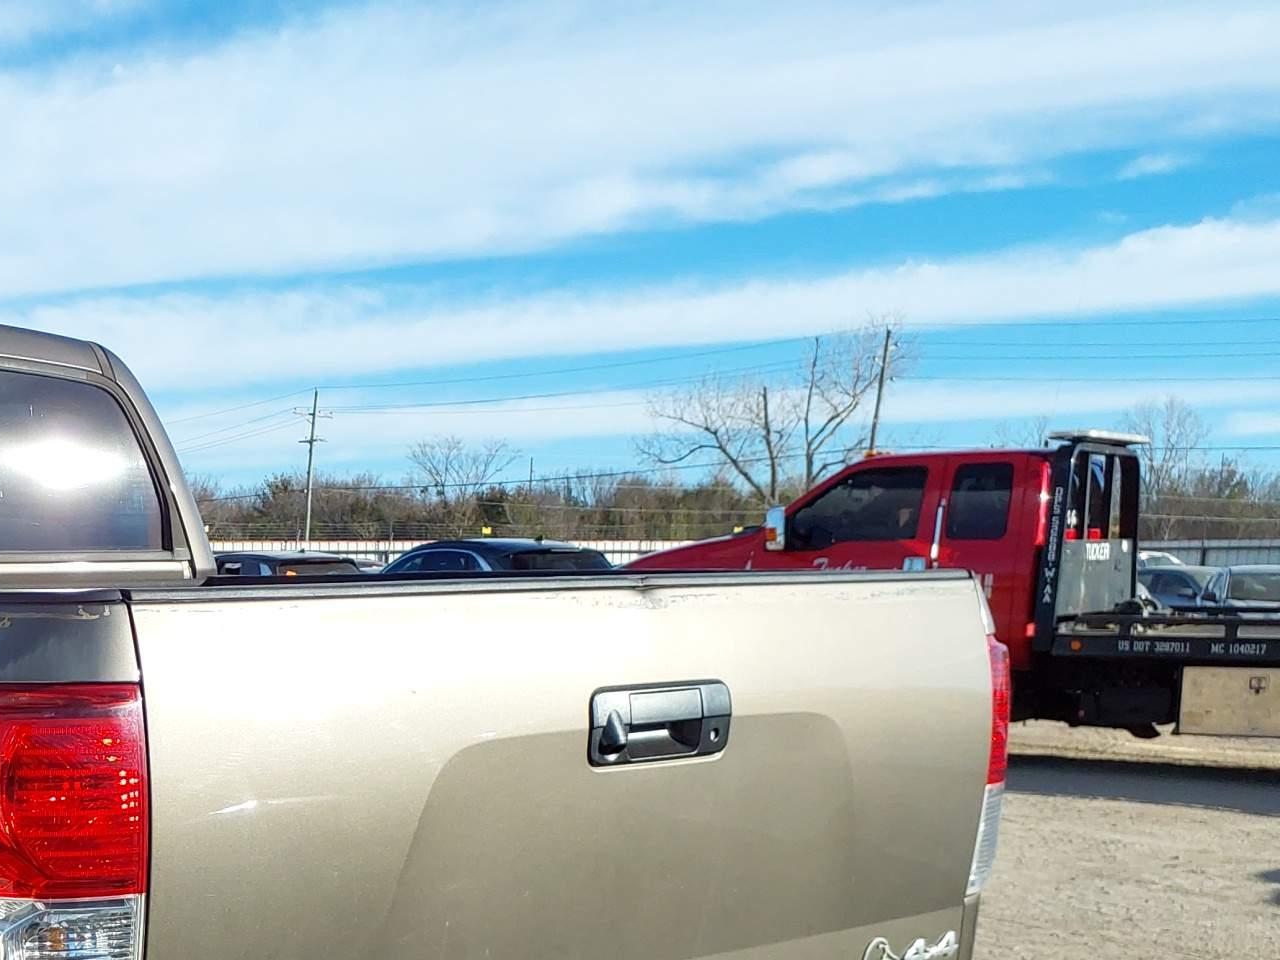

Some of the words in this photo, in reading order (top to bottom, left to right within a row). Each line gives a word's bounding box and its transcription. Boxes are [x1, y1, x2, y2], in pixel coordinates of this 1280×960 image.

[1085, 542, 1110, 561] TUCKER
[1118, 640, 1130, 651] US
[1133, 640, 1151, 652] DOT
[1211, 643, 1225, 655] MC
[1229, 643, 1267, 656] 1040217
